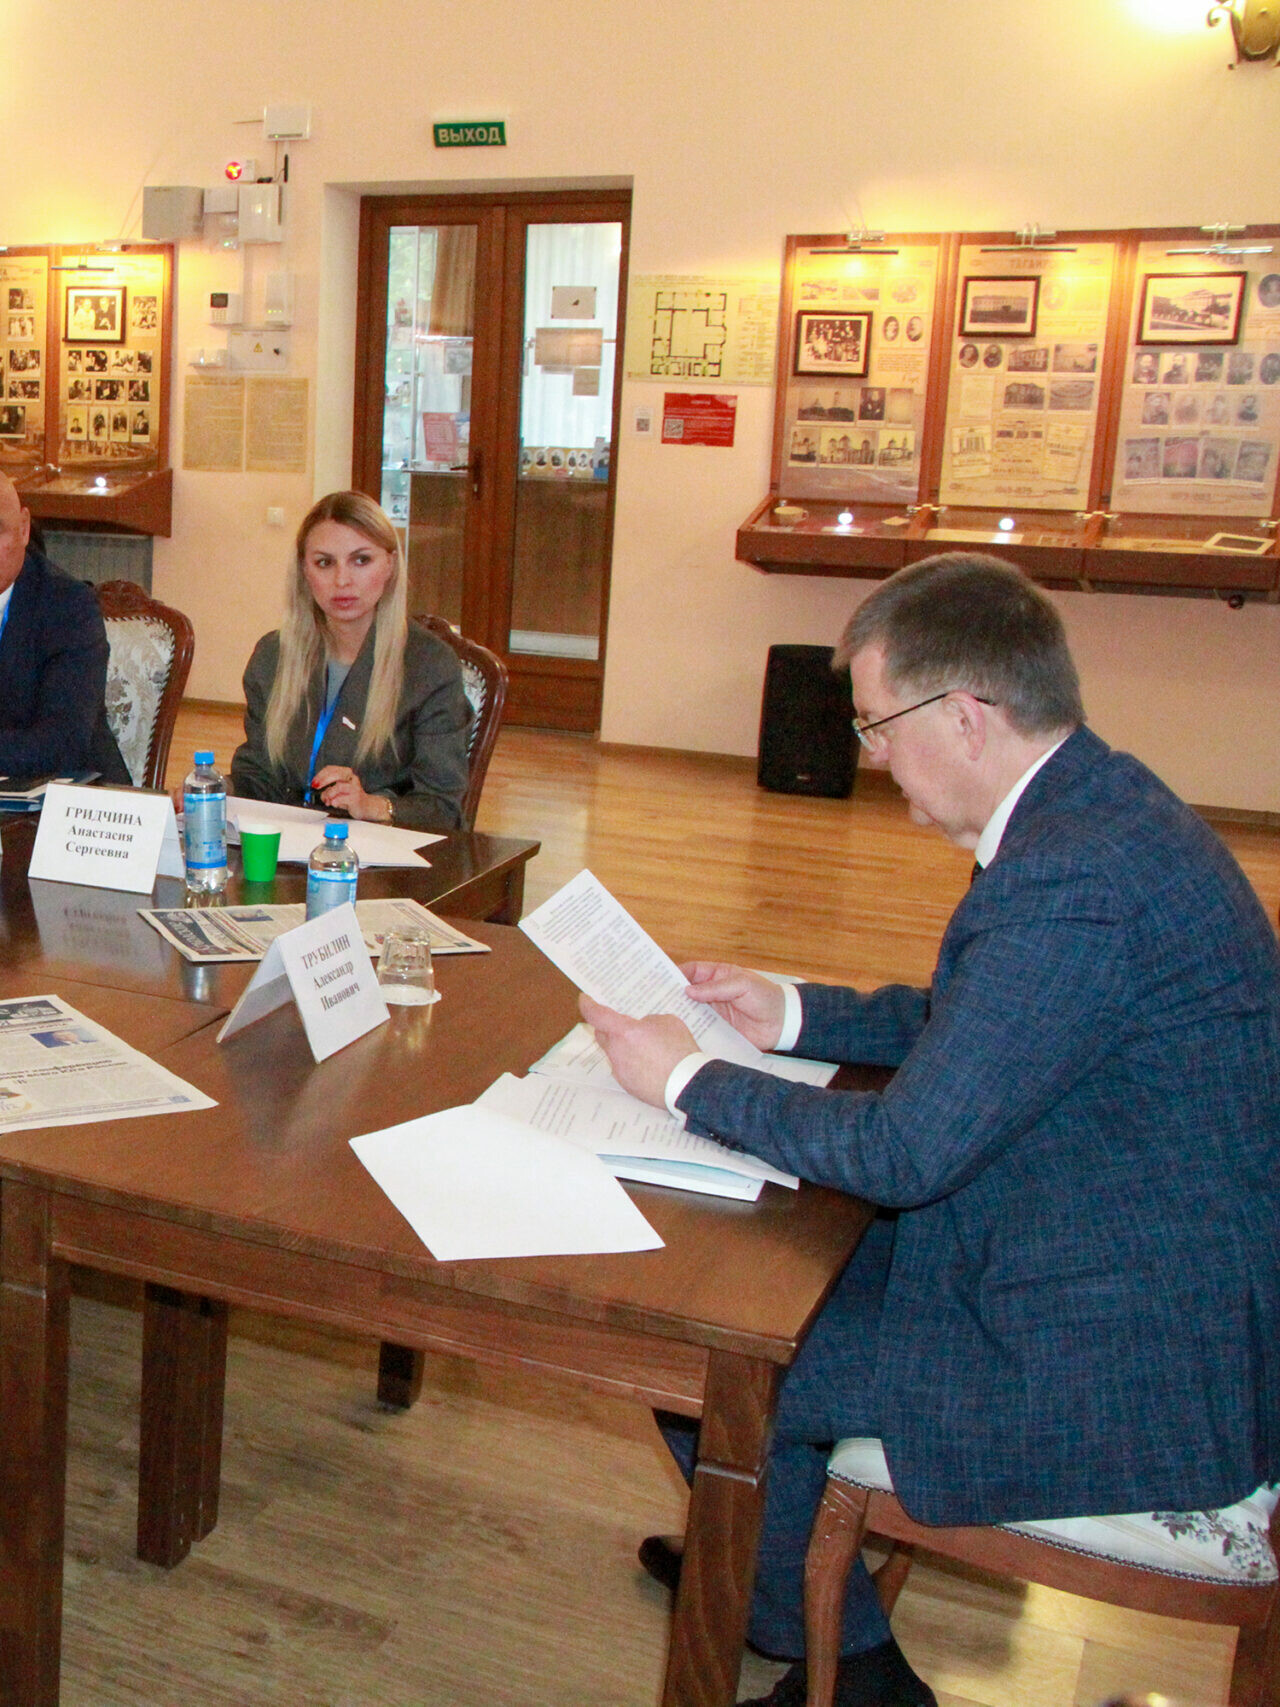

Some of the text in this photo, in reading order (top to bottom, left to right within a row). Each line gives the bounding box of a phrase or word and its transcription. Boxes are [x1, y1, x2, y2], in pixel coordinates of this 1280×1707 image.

[438, 127, 501, 144] ВЫХОД
[65, 806, 142, 826] ГРИДЧИНА
[68, 824, 134, 842] Анастасия
[65, 840, 129, 859] Сергеевна
[301, 934, 351, 970] ТРУБИЛИН
[313, 961, 354, 990] Александр
[320, 982, 360, 1011] Иванович
